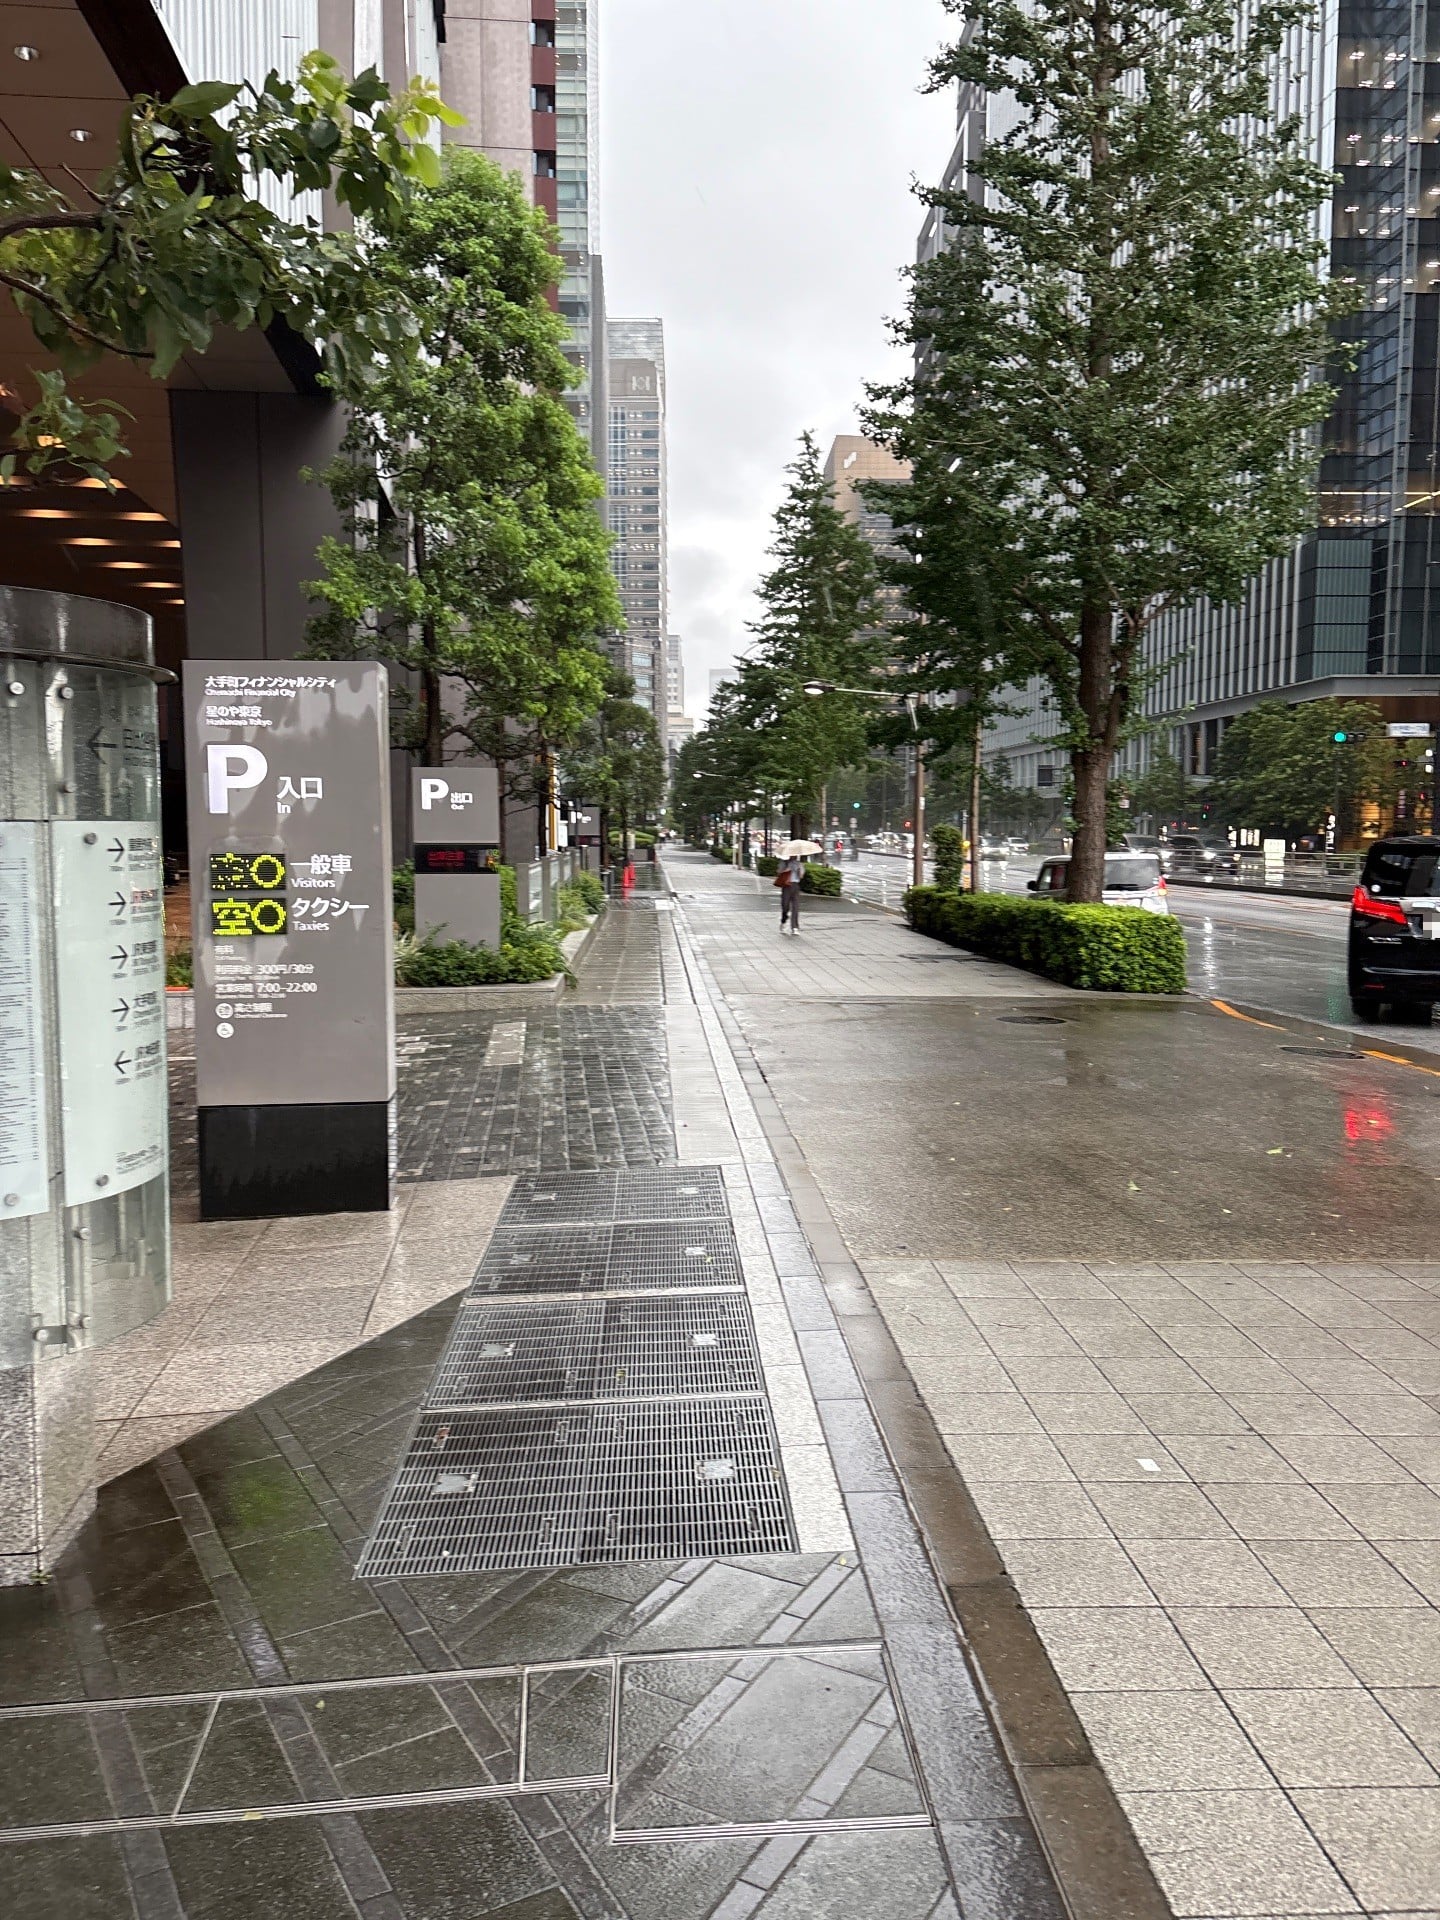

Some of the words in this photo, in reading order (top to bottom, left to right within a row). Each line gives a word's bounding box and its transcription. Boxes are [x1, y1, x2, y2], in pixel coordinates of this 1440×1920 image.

[207, 744, 268, 814] P
[276, 776, 323, 799] 入口
[421, 778, 449, 810] P
[277, 802, 291, 814] In
[290, 854, 352, 875] 一般車
[291, 878, 336, 888] Visitors
[291, 897, 369, 917] タクシー
[292, 921, 330, 931] Taxies
